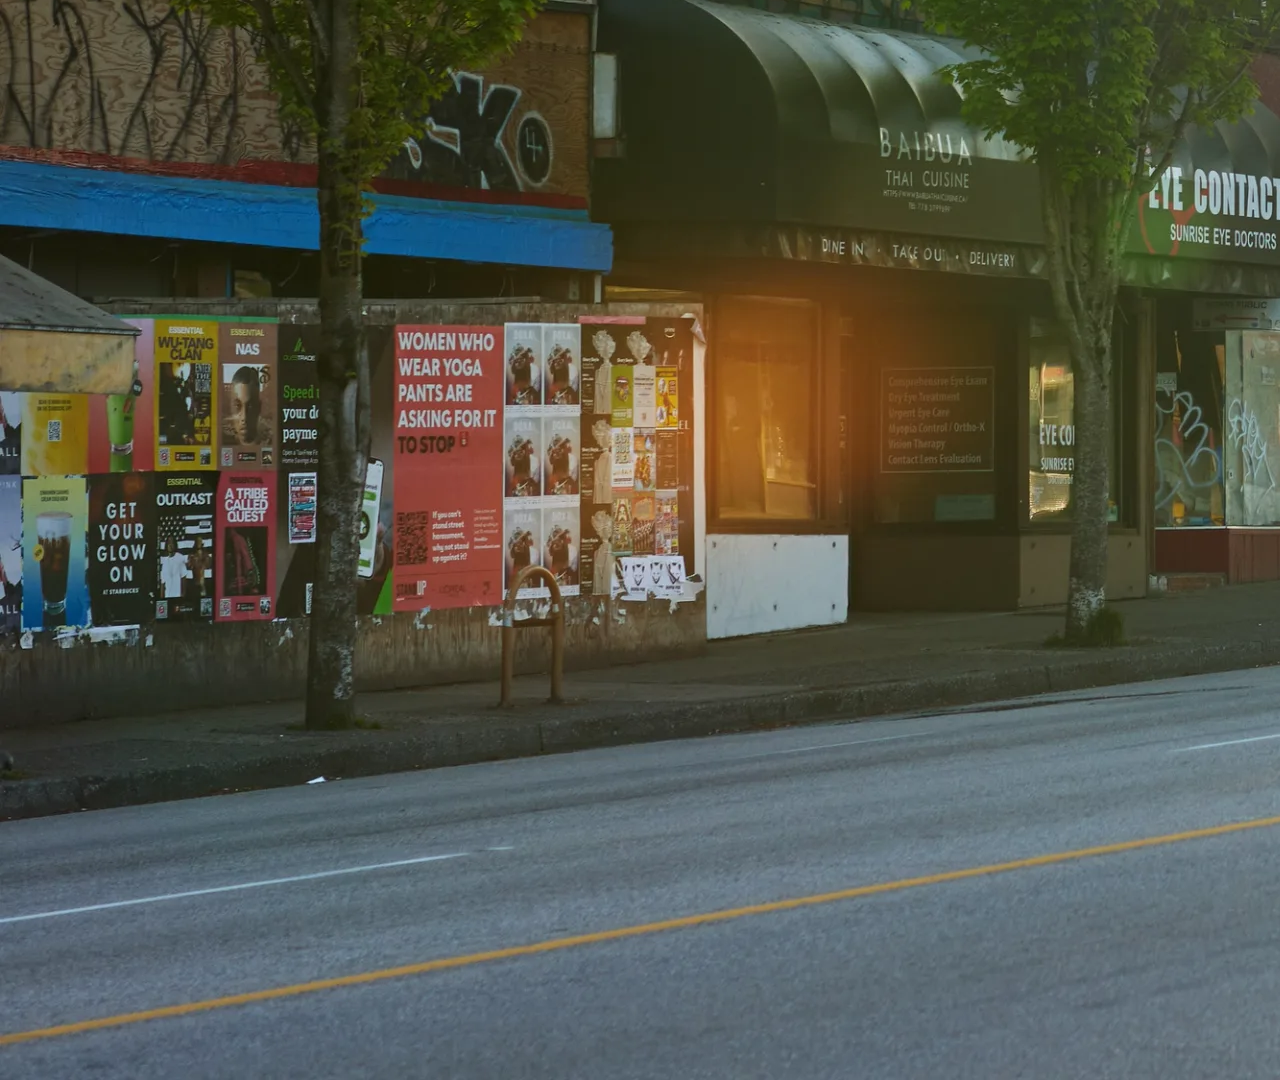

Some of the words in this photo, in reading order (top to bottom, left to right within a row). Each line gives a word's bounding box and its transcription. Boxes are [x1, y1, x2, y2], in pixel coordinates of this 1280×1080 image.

[879, 127, 972, 166] BAIBUA
[885, 170, 913, 187] THAI
[922, 170, 970, 188] CUISINE
[1148, 166, 1183, 211] EYE
[1170, 223, 1210, 244] SUNRISE
[1213, 227, 1231, 246] EYE
[1234, 230, 1277, 250] DOCTORS
[821, 238, 845, 255] DINE
[851, 242, 864, 256] IN
[970, 251, 1016, 267] DELIVERY
[169, 326, 204, 335] ESSENTIAL
[230, 328, 264, 336] ESSENTIAL
[158, 337, 213, 349] WU-TANG
[398, 332, 456, 351] WOMEN
[458, 333, 495, 351] WHO
[170, 349, 202, 360] CLAN
[235, 343, 260, 355] NAS
[398, 358, 440, 376] WEAR
[442, 358, 483, 377] YOGA
[888, 375, 949, 389] Comprehensive
[950, 375, 964, 388] Eye
[283, 384, 314, 402] Speed
[398, 384, 443, 402] PANTS
[445, 384, 473, 402] ARE
[888, 393, 902, 404] Dry
[903, 393, 917, 404] Eye
[919, 392, 960, 402] Treatment
[282, 408, 307, 422] your
[398, 410, 451, 428] ASKING
[454, 409, 482, 427] FOR
[483, 409, 496, 427] IT
[888, 408, 916, 420] Urgent
[918, 408, 931, 419] Eye
[932, 407, 950, 417] Care
[888, 423, 917, 435] Myopia
[919, 423, 948, 433] Control
[1039, 424, 1057, 446] EYE
[398, 436, 417, 454] TO
[419, 436, 456, 454] STOP
[888, 439, 912, 449] Vision
[914, 438, 946, 450] Therapy
[888, 455, 918, 464] Contact
[920, 454, 938, 464] Lens
[939, 453, 982, 464] Evaluation
[1040, 457, 1067, 471] SUNRISE
[167, 477, 202, 486] ESSENTIAL
[156, 493, 213, 506] OUTKAST
[224, 489, 234, 500] A
[236, 487, 268, 499] TRIBE
[106, 502, 137, 519] GET
[224, 499, 268, 511] CALLED
[227, 511, 266, 523] QUEST
[432, 511, 437, 519] If
[438, 512, 447, 521] you
[448, 510, 461, 518] can't
[99, 523, 144, 540] YOUR
[432, 521, 448, 529] stand
[448, 521, 464, 529] street
[97, 544, 146, 562] GLOW
[432, 544, 444, 553] why
[454, 541, 469, 550] stand
[440, 554, 459, 563] against
[460, 553, 468, 561] it?
[110, 566, 133, 582] ON
